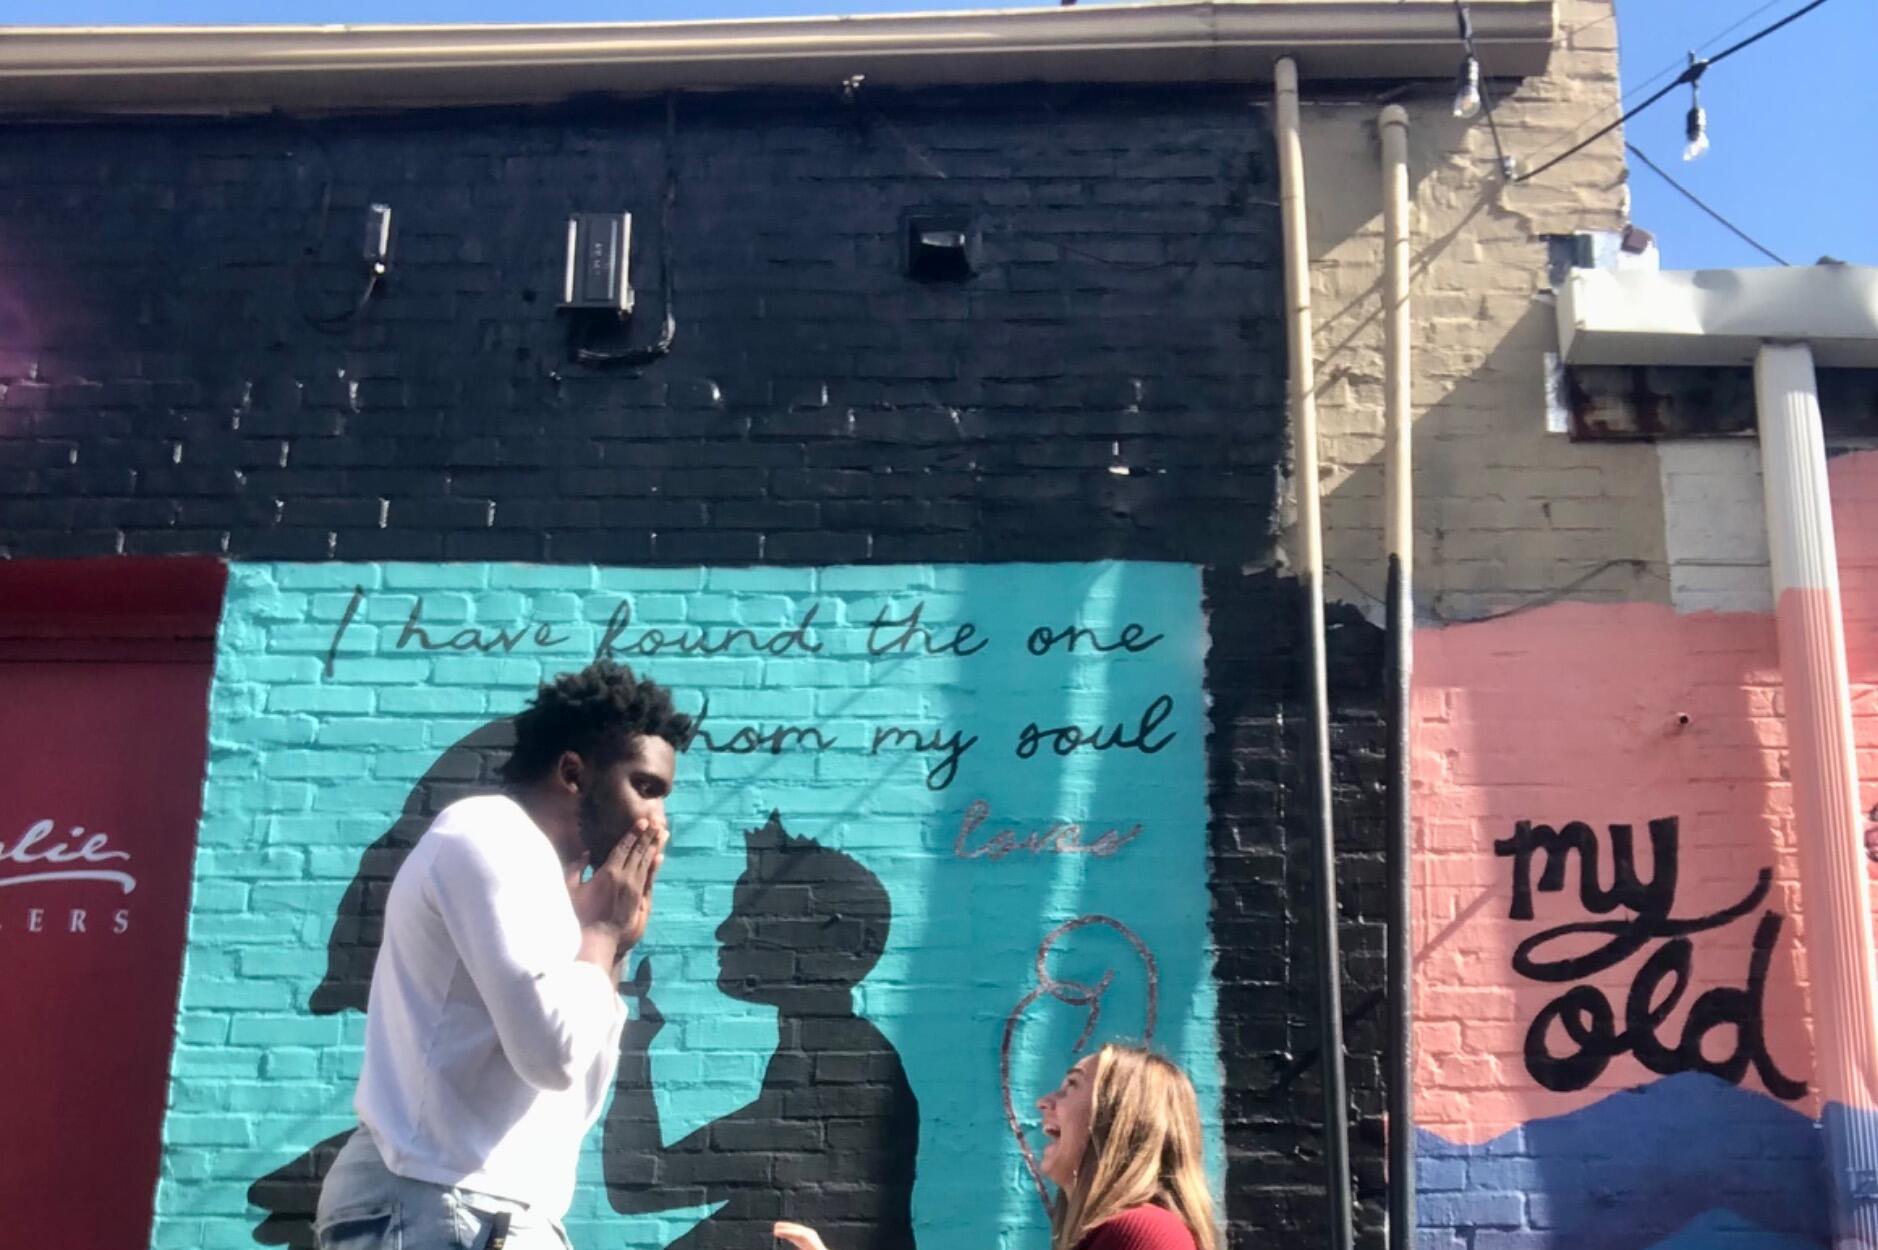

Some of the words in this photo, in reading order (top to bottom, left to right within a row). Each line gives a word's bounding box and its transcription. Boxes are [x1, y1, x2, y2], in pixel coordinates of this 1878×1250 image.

[323, 584, 364, 679] I
[396, 597, 570, 653] have
[593, 599, 824, 663] found
[867, 600, 989, 657] the
[1026, 621, 1165, 656] one
[680, 688, 838, 755] hom
[871, 720, 979, 791] my
[1015, 694, 1177, 760] soul
[0, 818, 131, 863] lie
[0, 907, 130, 935] ERS
[1493, 815, 1774, 983] my
[1522, 909, 1809, 1101] old
